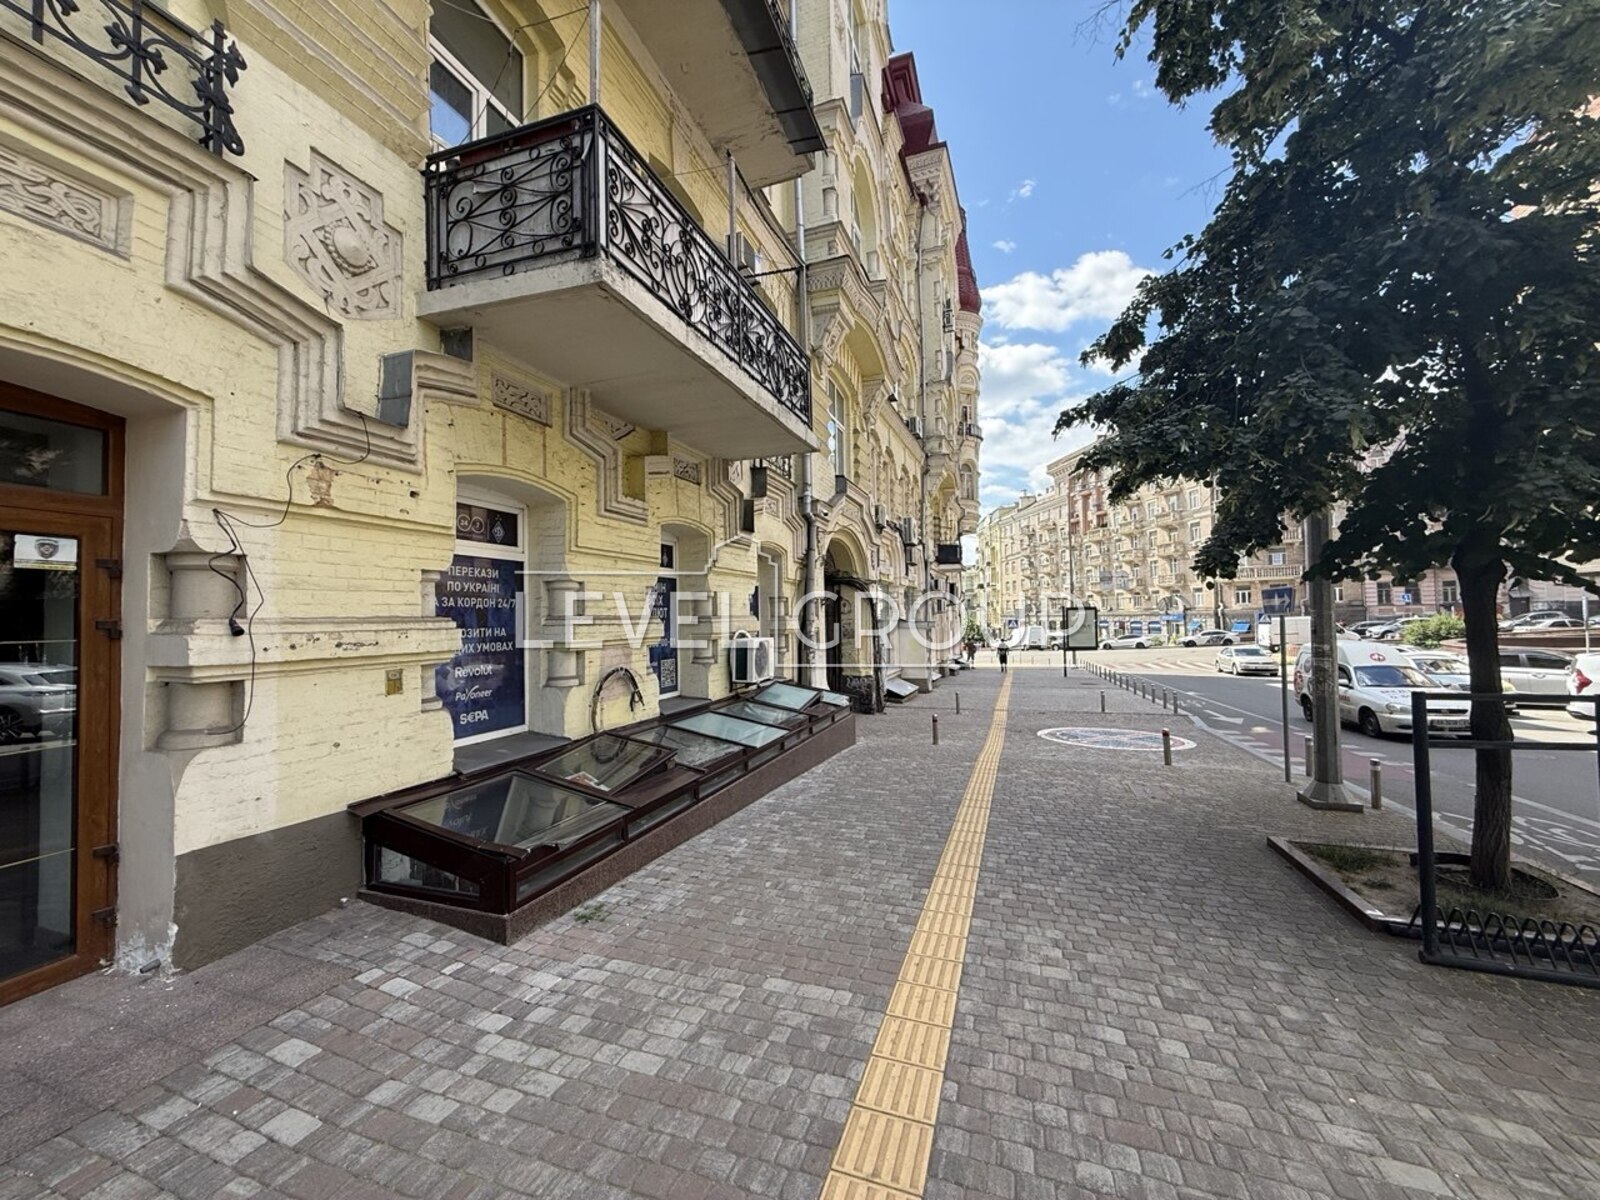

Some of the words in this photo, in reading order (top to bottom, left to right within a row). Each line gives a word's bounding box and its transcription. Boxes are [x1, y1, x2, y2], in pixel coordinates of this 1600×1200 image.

[448, 566, 499, 579] ПЕРЕКАЗИ
[447, 581, 460, 592] ПО
[463, 582, 500, 593] УКРАЇНІ
[441, 597, 455, 607] ЗА
[457, 597, 496, 609] КОРДОН
[498, 598, 517, 609] 24/7
[461, 627, 491, 638] ОЗИТИ
[494, 627, 507, 637] НА
[476, 641, 513, 652] УМОВАХ
[454, 664, 493, 678] Revolut
